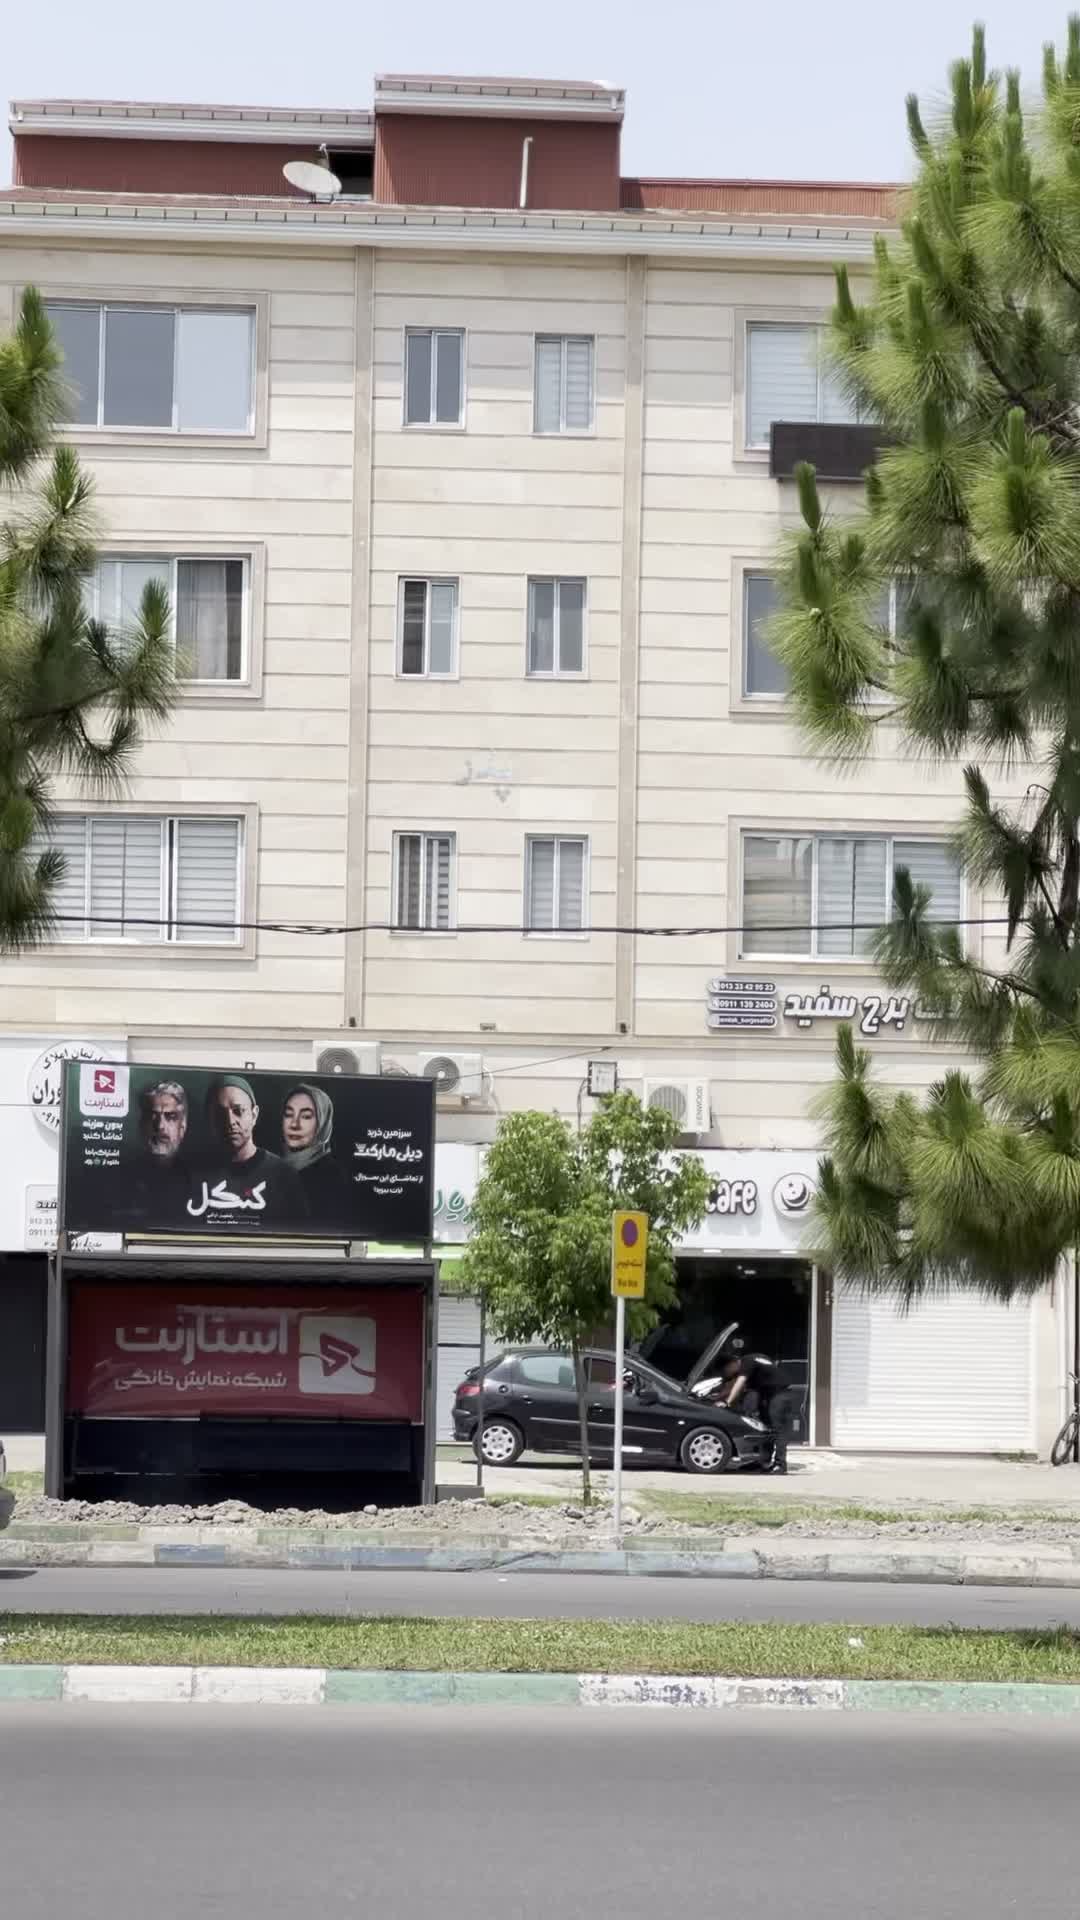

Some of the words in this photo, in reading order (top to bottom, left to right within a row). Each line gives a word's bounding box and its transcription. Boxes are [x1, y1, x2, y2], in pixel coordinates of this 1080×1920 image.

[783, 985, 857, 1027] سفید
[860, 997, 909, 1034] برج
[82, 1119, 104, 1130] هزینه
[105, 1121, 123, 1131] بدون
[367, 1128, 383, 1138] خرید
[383, 1128, 412, 1139] سرزمین
[83, 1132, 101, 1141] کنید
[102, 1132, 123, 1141] تماشا
[353, 1143, 397, 1161] مارکت
[396, 1144, 423, 1162] دیلی
[115, 1311, 289, 1366] استارنت
[114, 1368, 175, 1391] خانگی
[175, 1370, 230, 1391] نمایش
[231, 1370, 287, 1392] شبکه
